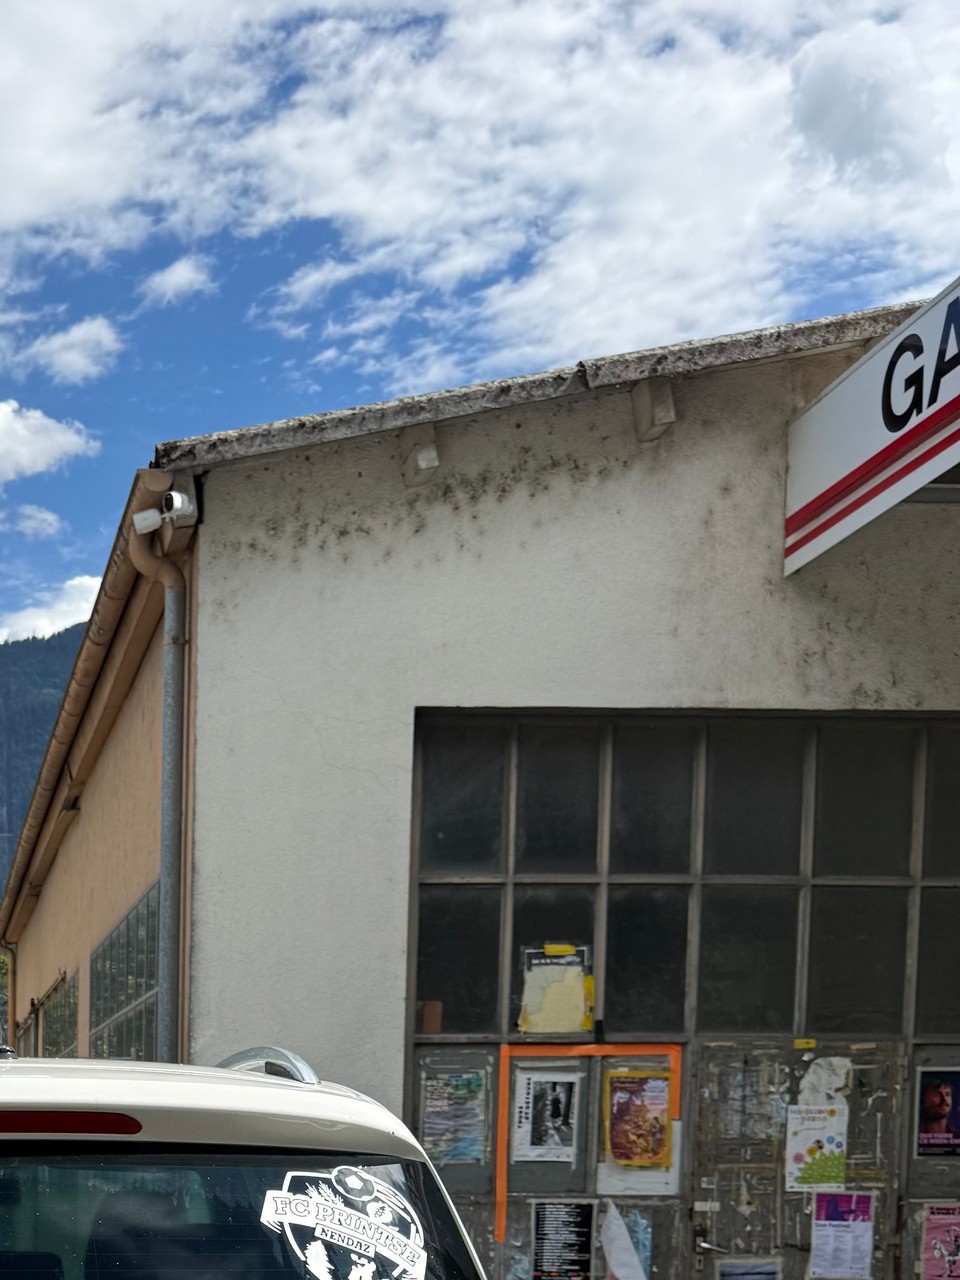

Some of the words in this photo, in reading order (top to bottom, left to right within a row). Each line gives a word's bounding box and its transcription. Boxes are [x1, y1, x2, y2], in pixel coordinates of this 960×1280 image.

[273, 1197, 310, 1218] FC
[315, 1203, 420, 1267] PRINTSE
[320, 1227, 372, 1254] NENDAZ
